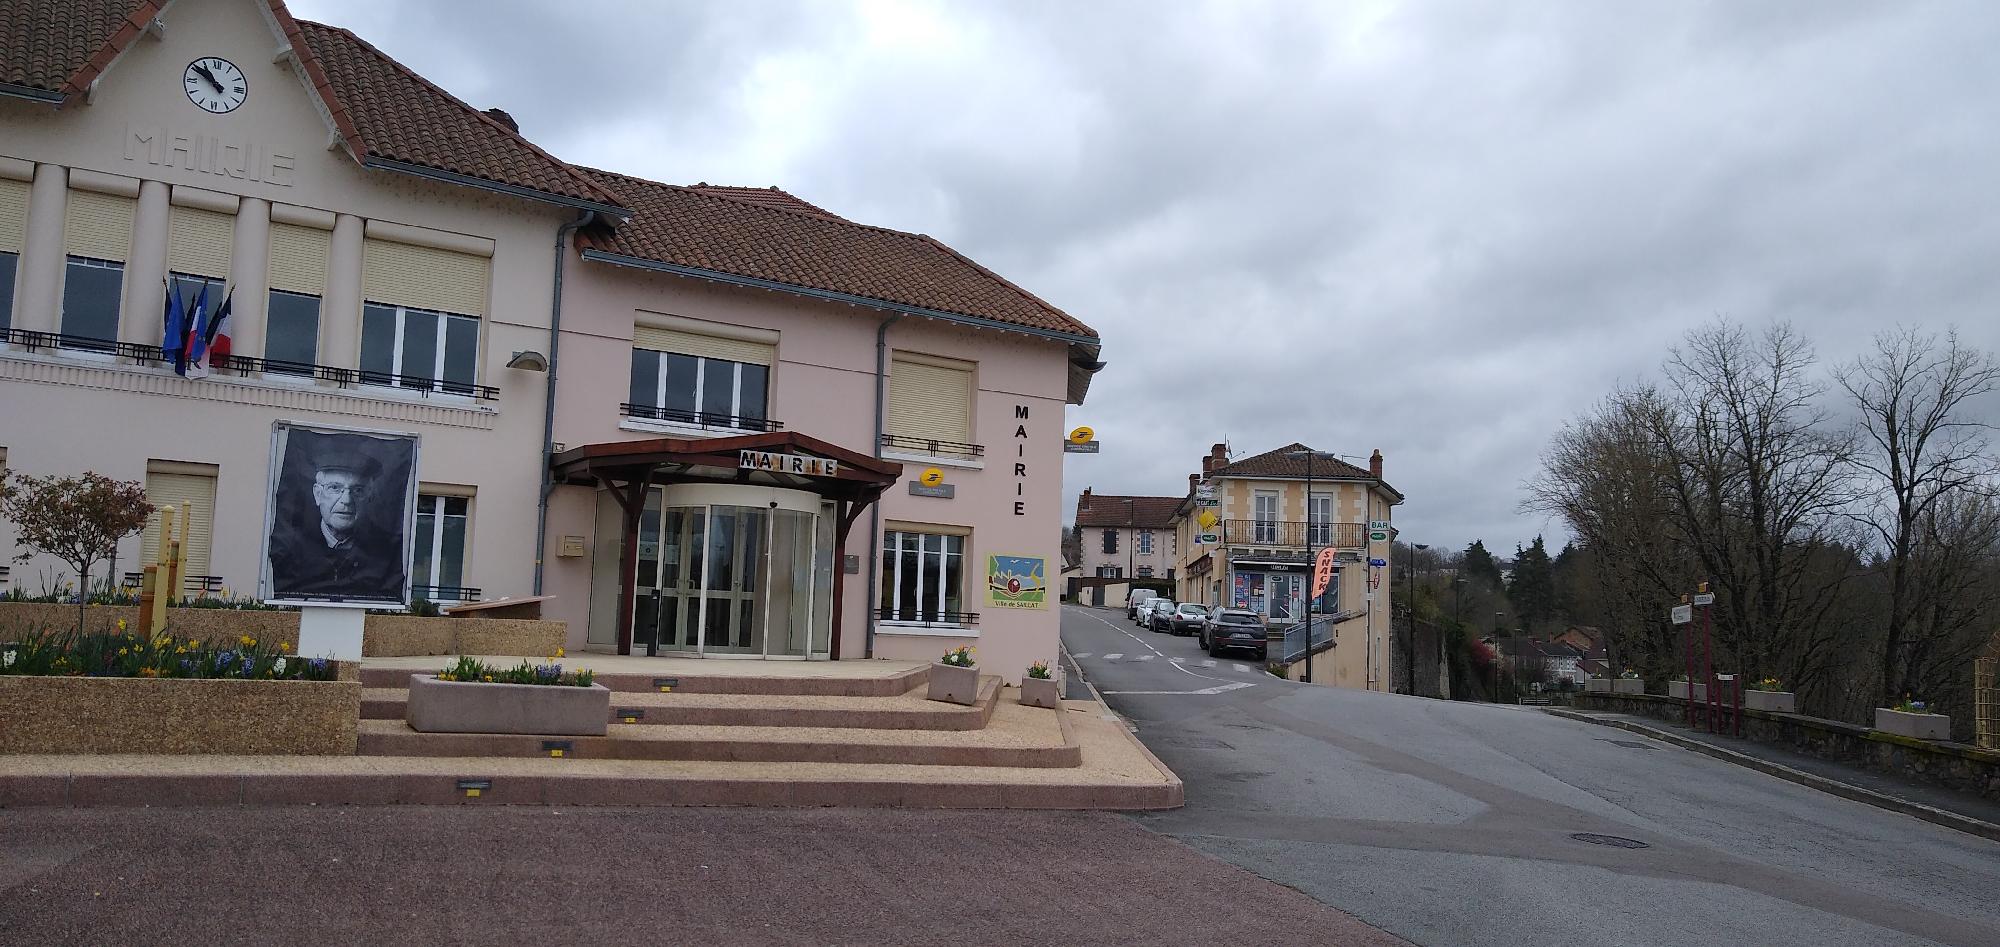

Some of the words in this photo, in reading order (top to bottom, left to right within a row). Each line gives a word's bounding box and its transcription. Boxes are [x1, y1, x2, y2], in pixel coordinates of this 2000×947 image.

[123, 121, 296, 187] MAIRIE
[740, 451, 836, 476] MAIRIE
[1014, 405, 1030, 516] MAIRIE
[1318, 550, 1332, 591] SNACK
